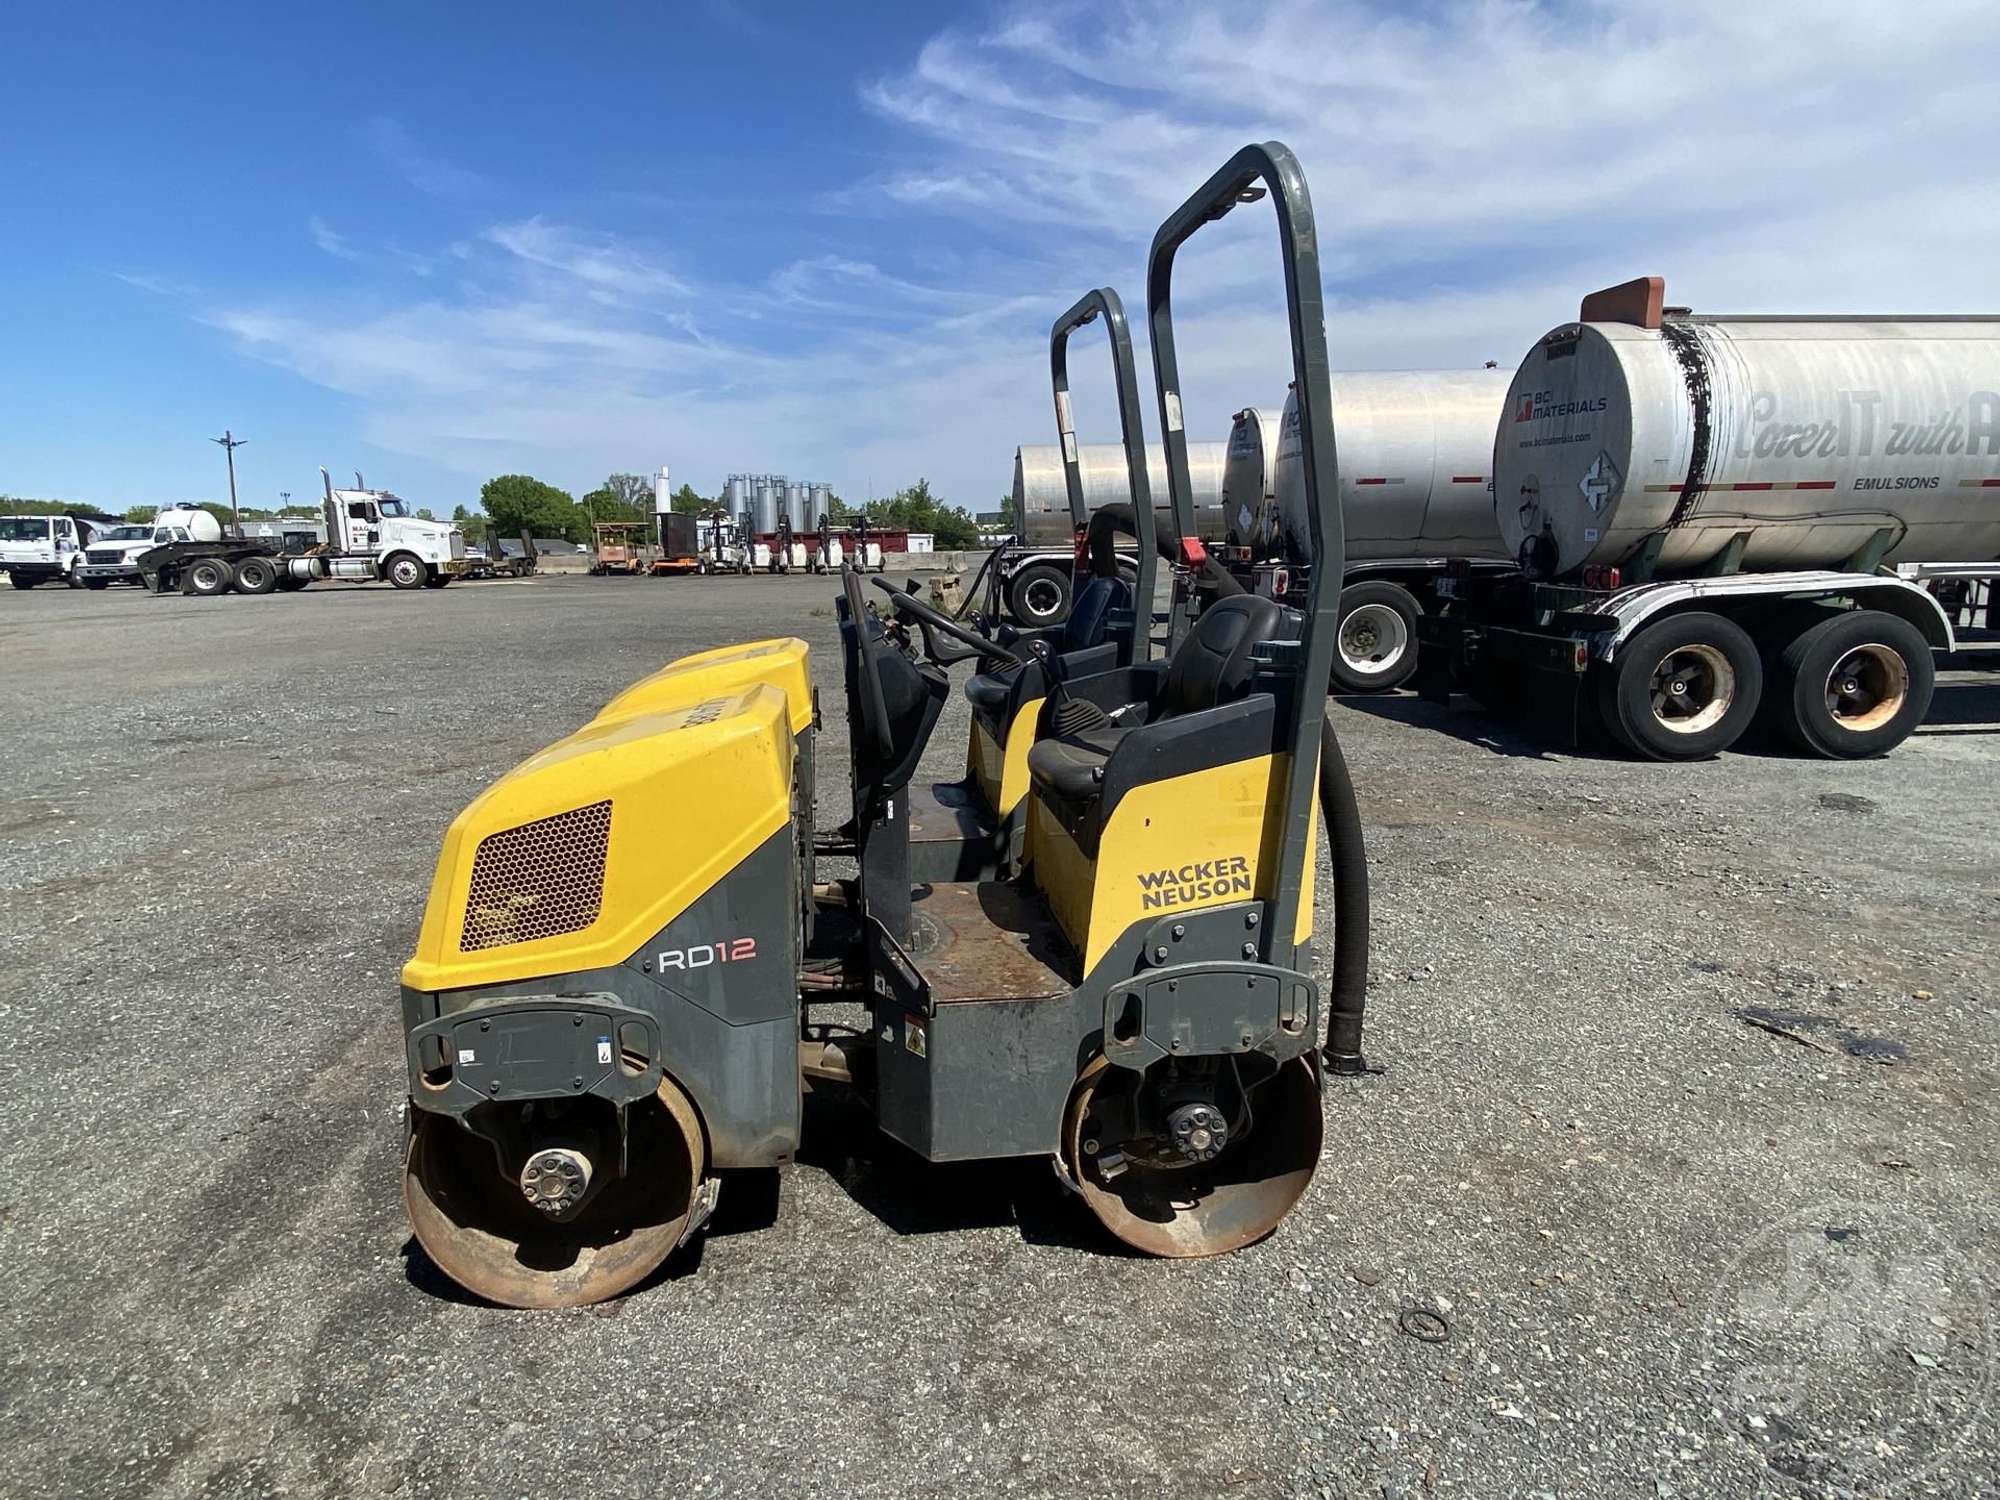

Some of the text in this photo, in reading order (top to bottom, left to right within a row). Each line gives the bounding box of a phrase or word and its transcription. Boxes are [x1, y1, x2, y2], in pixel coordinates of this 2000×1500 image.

[1532, 397, 1608, 420] MATERIALS
[1885, 406, 1965, 456] with
[1853, 476, 1940, 490] EMULSIONS
[1137, 856, 1249, 890] WACKER
[1141, 875, 1251, 910] NEUSON
[658, 937, 757, 973] RD12
